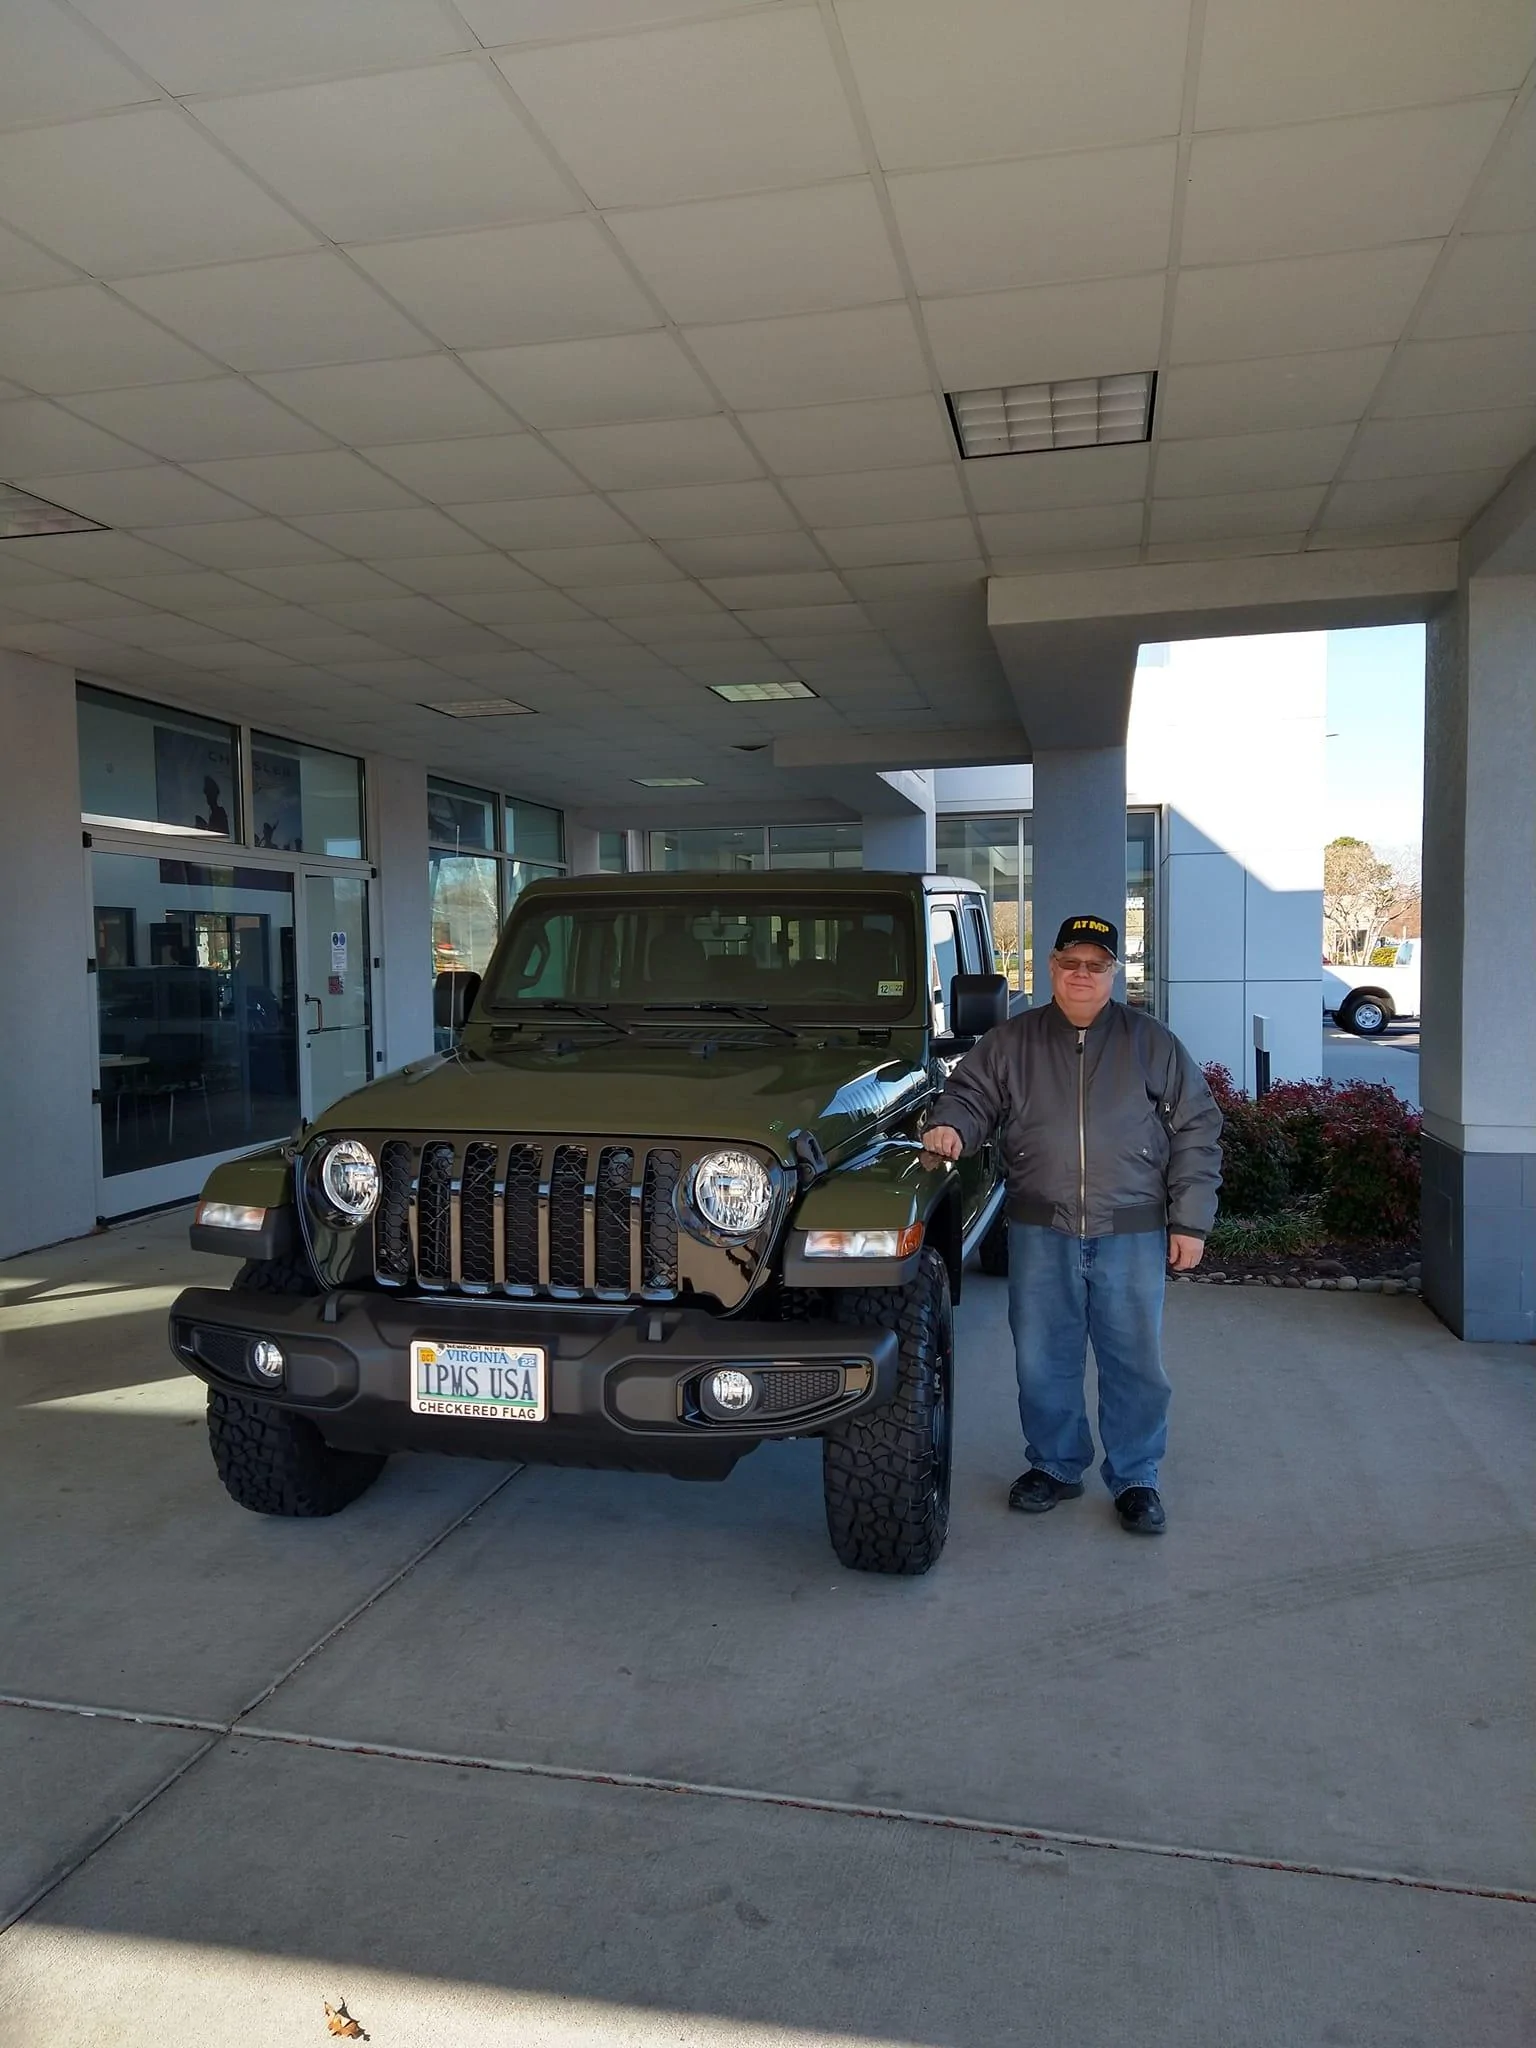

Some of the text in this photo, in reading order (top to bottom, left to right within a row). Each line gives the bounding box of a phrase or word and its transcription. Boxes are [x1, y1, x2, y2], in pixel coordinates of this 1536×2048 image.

[881, 984, 888, 993] 12
[421, 1353, 434, 1363] OCT
[446, 1350, 508, 1364] VIRGINIA
[520, 1358, 536, 1367] 22
[423, 1363, 535, 1401] IPMS USA
[418, 1401, 537, 1420] CHECKERED FLAG
